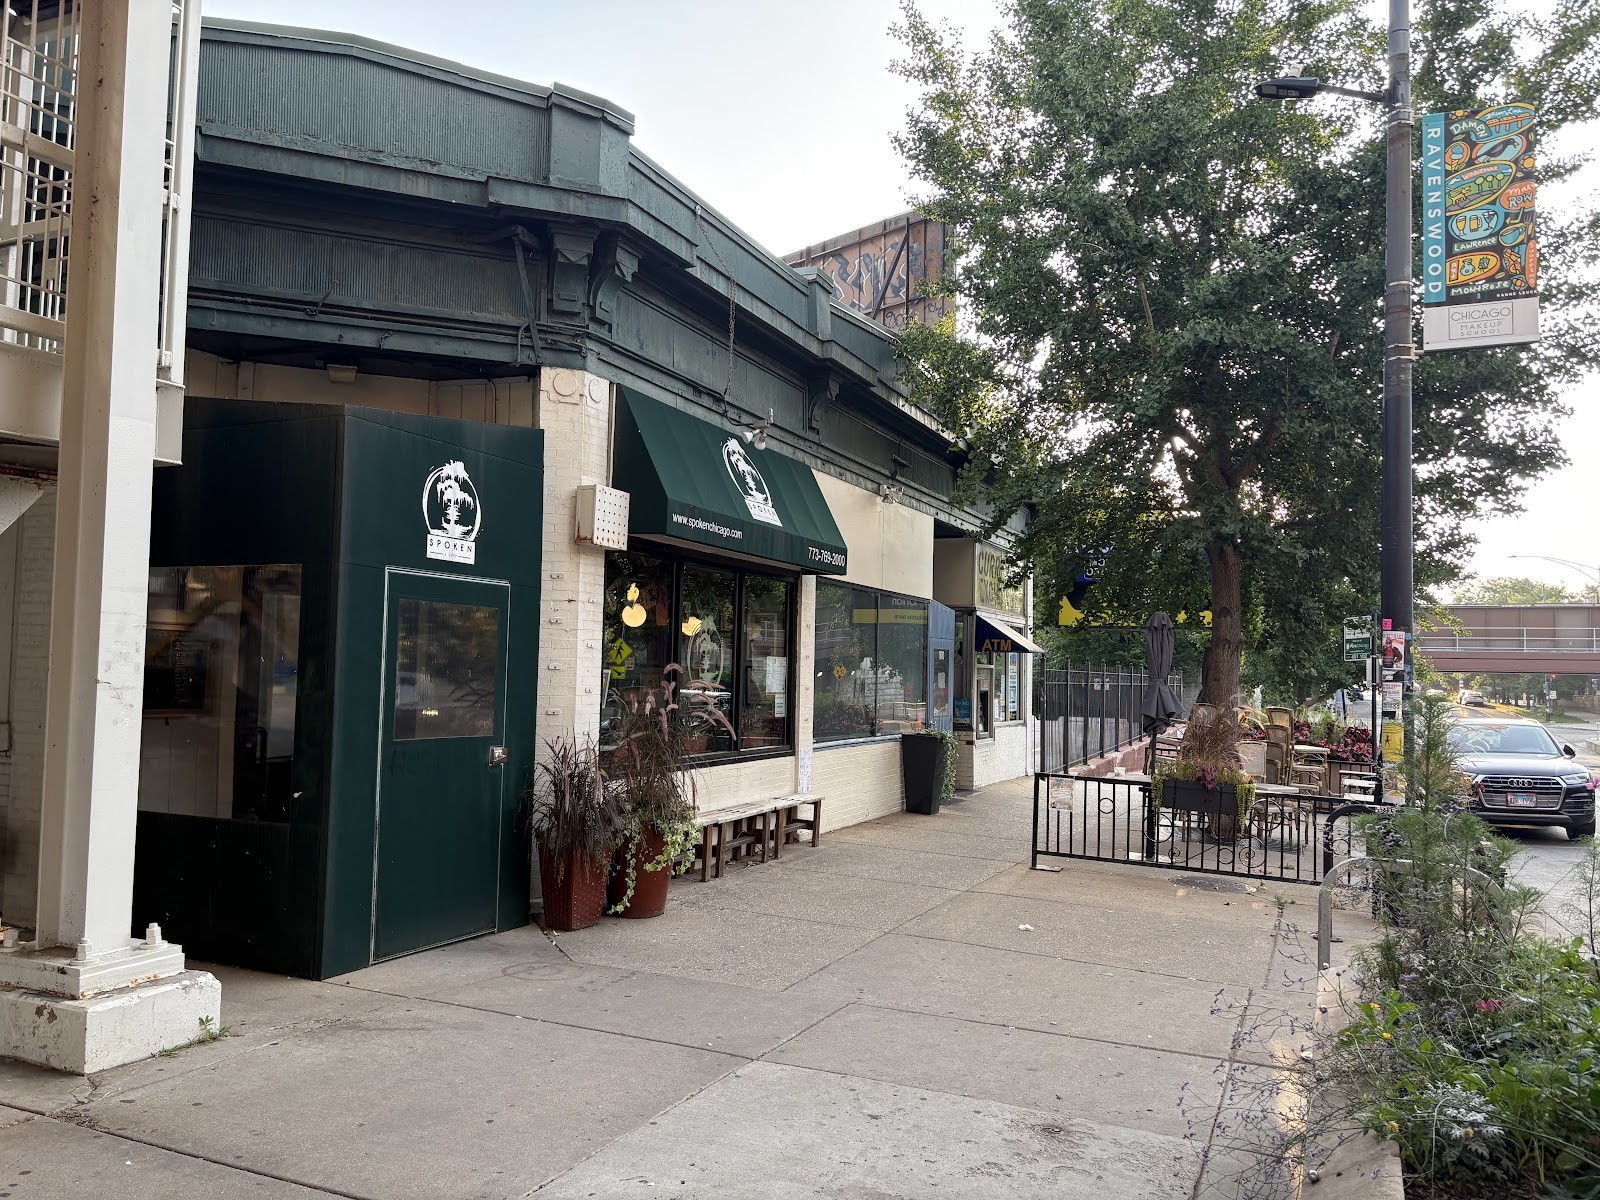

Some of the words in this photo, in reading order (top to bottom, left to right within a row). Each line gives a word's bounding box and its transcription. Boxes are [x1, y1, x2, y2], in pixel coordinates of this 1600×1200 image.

[1450, 120, 1488, 138] DAMEN
[1508, 194, 1533, 208] ROW
[1427, 127, 1442, 294] RAVENSWOOD
[1451, 307, 1511, 321] CHICAGO
[1460, 321, 1502, 331] MAKEUP
[672, 512, 743, 540] www.spokenchicago.com
[429, 538, 473, 553] SPOKEN
[808, 546, 846, 567] 773-769-2000
[982, 638, 1012, 651] ATM
